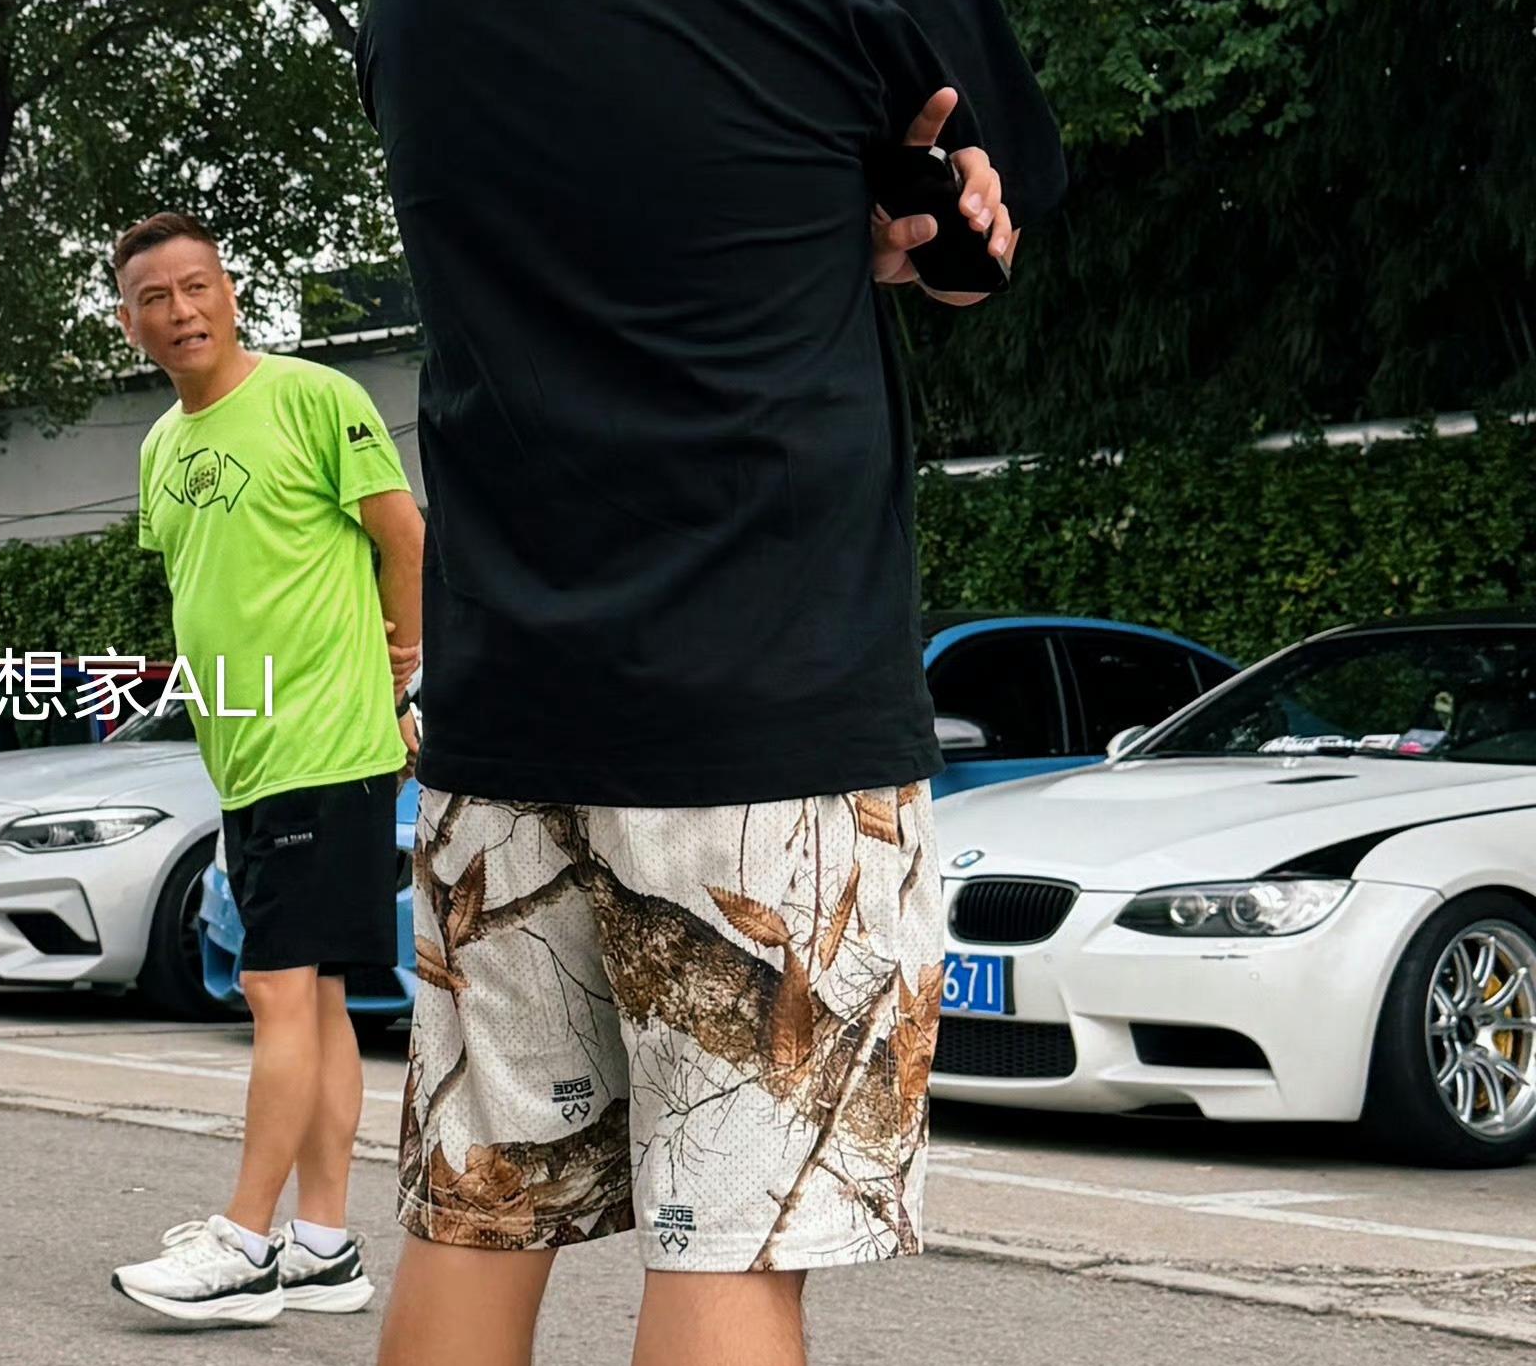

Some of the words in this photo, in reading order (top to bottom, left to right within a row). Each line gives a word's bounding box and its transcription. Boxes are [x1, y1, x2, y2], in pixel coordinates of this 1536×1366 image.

[943, 961, 994, 1005] 671
[553, 1079, 592, 1096] EDGE
[658, 1208, 694, 1222] EDGE
